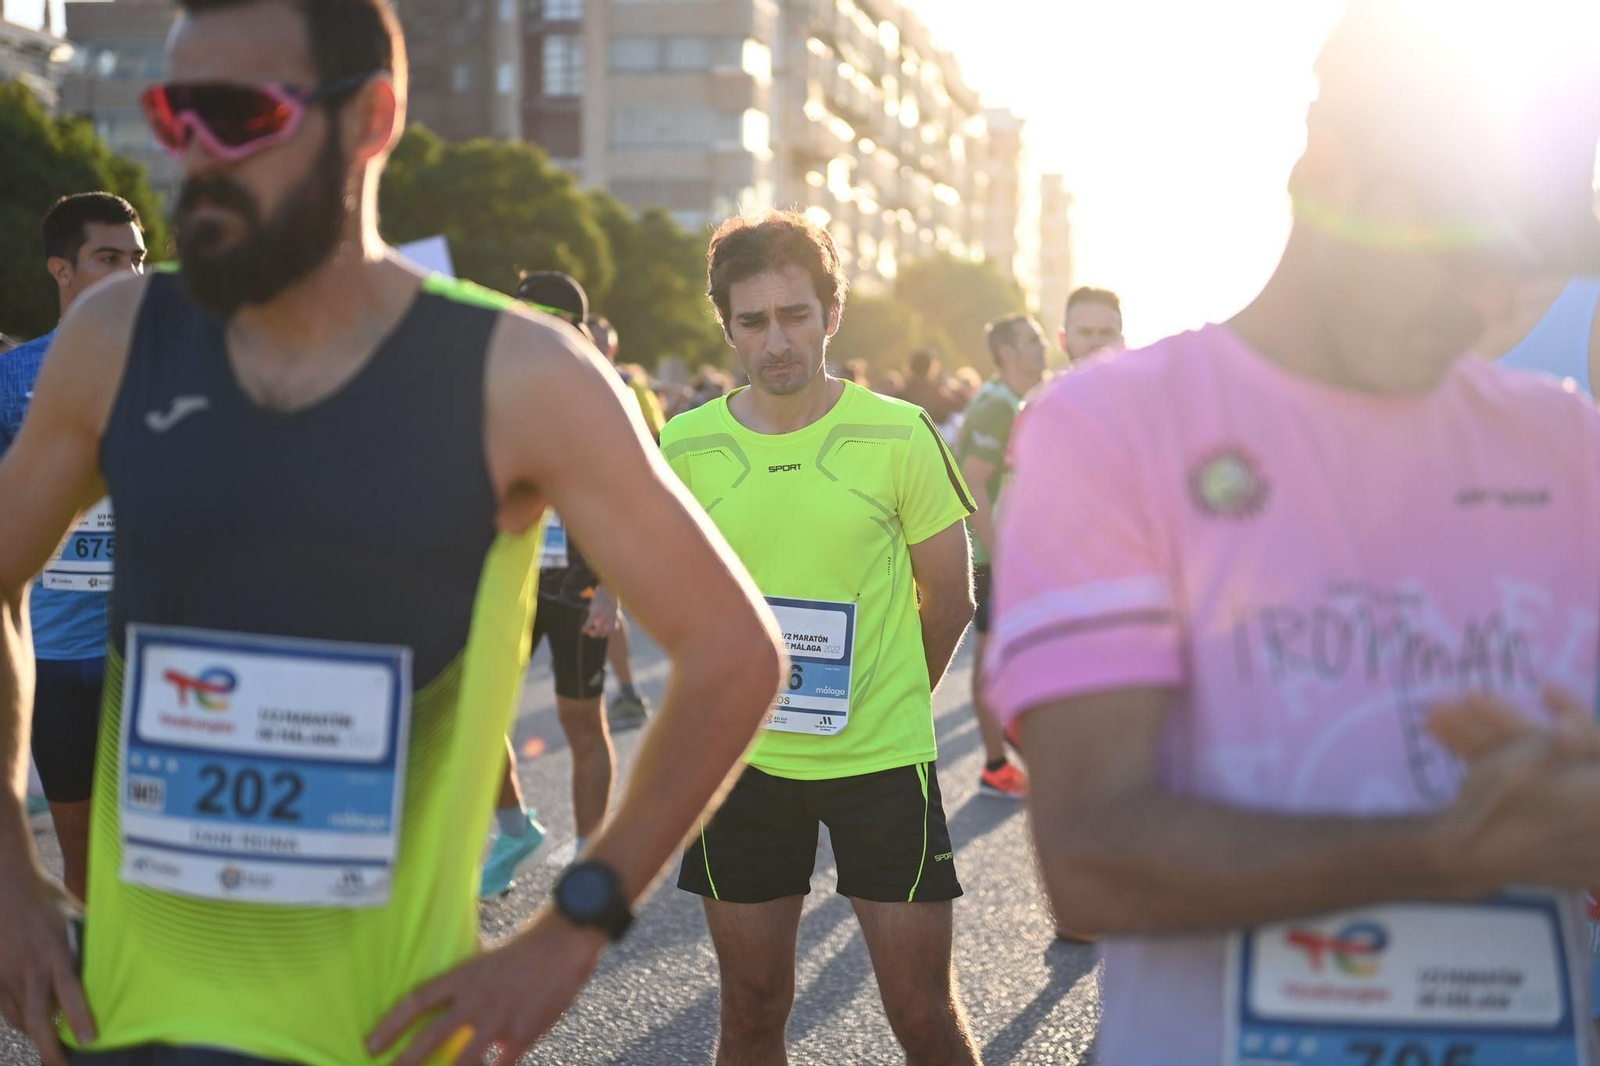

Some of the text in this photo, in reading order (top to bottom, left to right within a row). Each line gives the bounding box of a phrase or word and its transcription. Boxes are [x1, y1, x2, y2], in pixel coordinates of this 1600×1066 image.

[769, 463, 801, 473] SPORT
[793, 633, 829, 643] MARATÓN
[790, 642, 822, 652] MÁLAGA
[823, 645, 841, 654] 2022
[815, 686, 846, 697] málaga
[196, 763, 305, 822] 202
